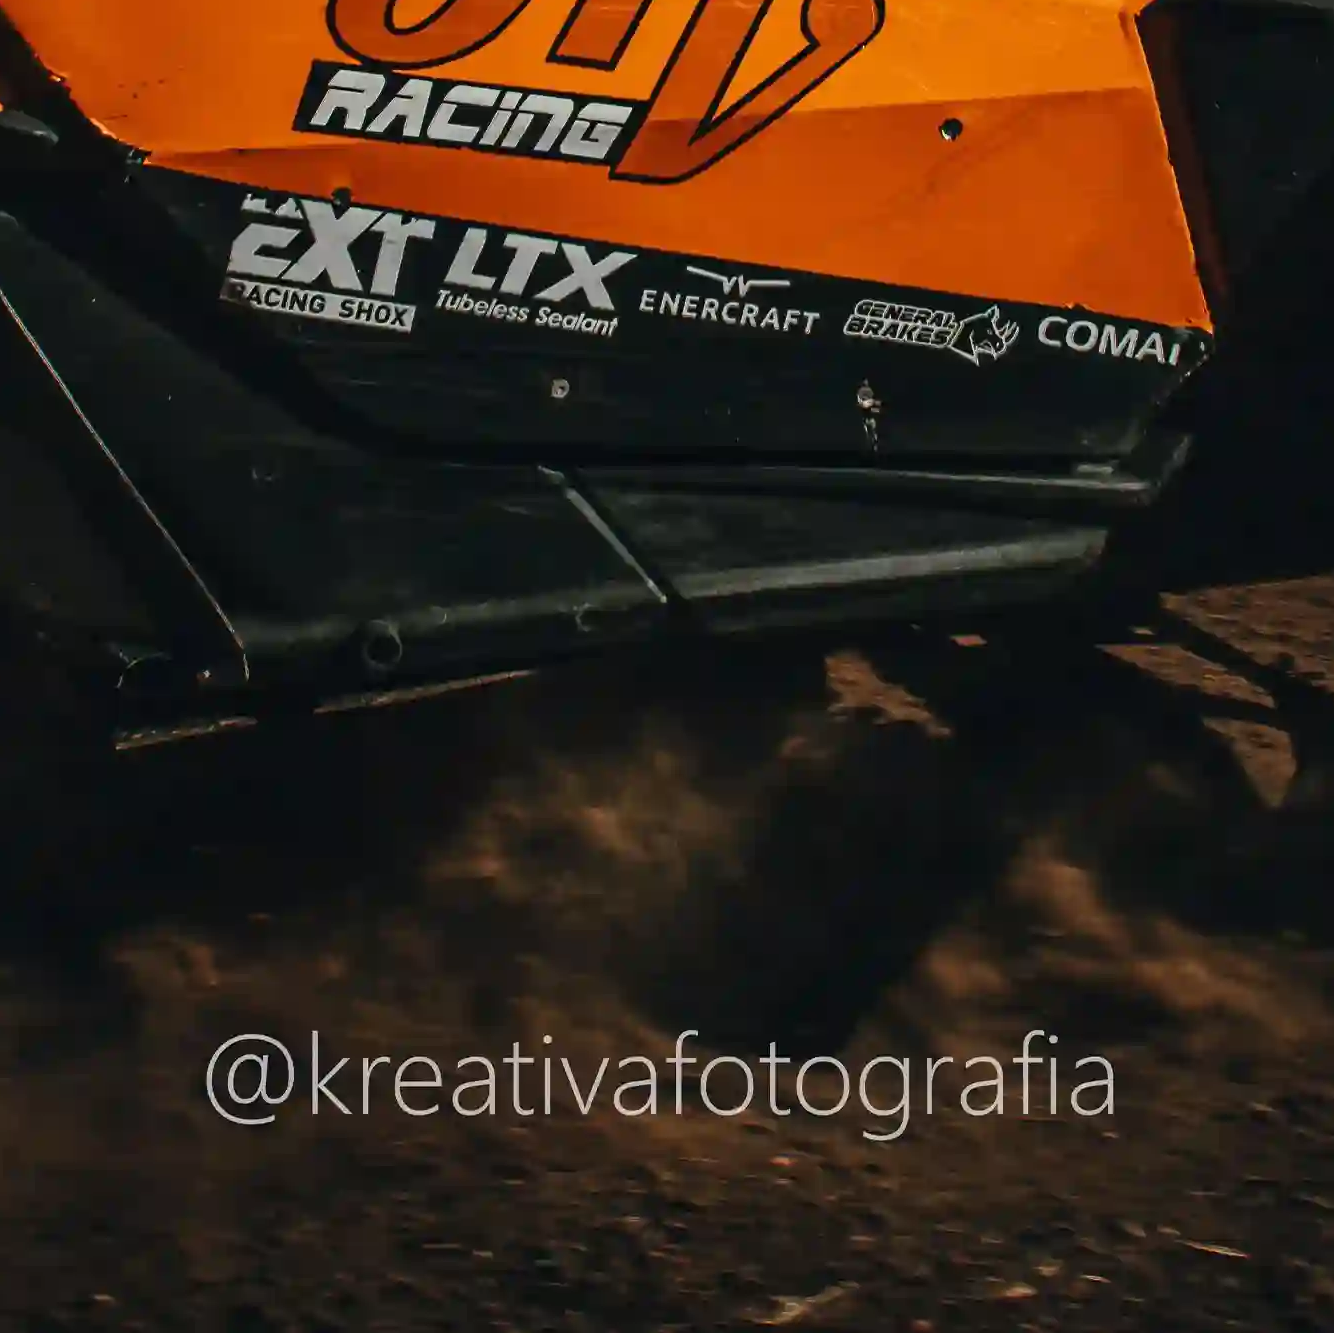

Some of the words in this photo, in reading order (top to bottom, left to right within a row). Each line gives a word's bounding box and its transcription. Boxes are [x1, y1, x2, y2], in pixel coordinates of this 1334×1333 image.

[308, 69, 637, 159] RACING
[442, 227, 639, 311] LTX
[227, 281, 327, 314] RACING
[338, 299, 409, 328] SHOX
[434, 288, 529, 324] Tubeless
[535, 306, 619, 338] Sealant
[639, 289, 821, 336] ENERCRAFT
[853, 299, 959, 330] GENERAL
[843, 314, 959, 349] BRAKES
